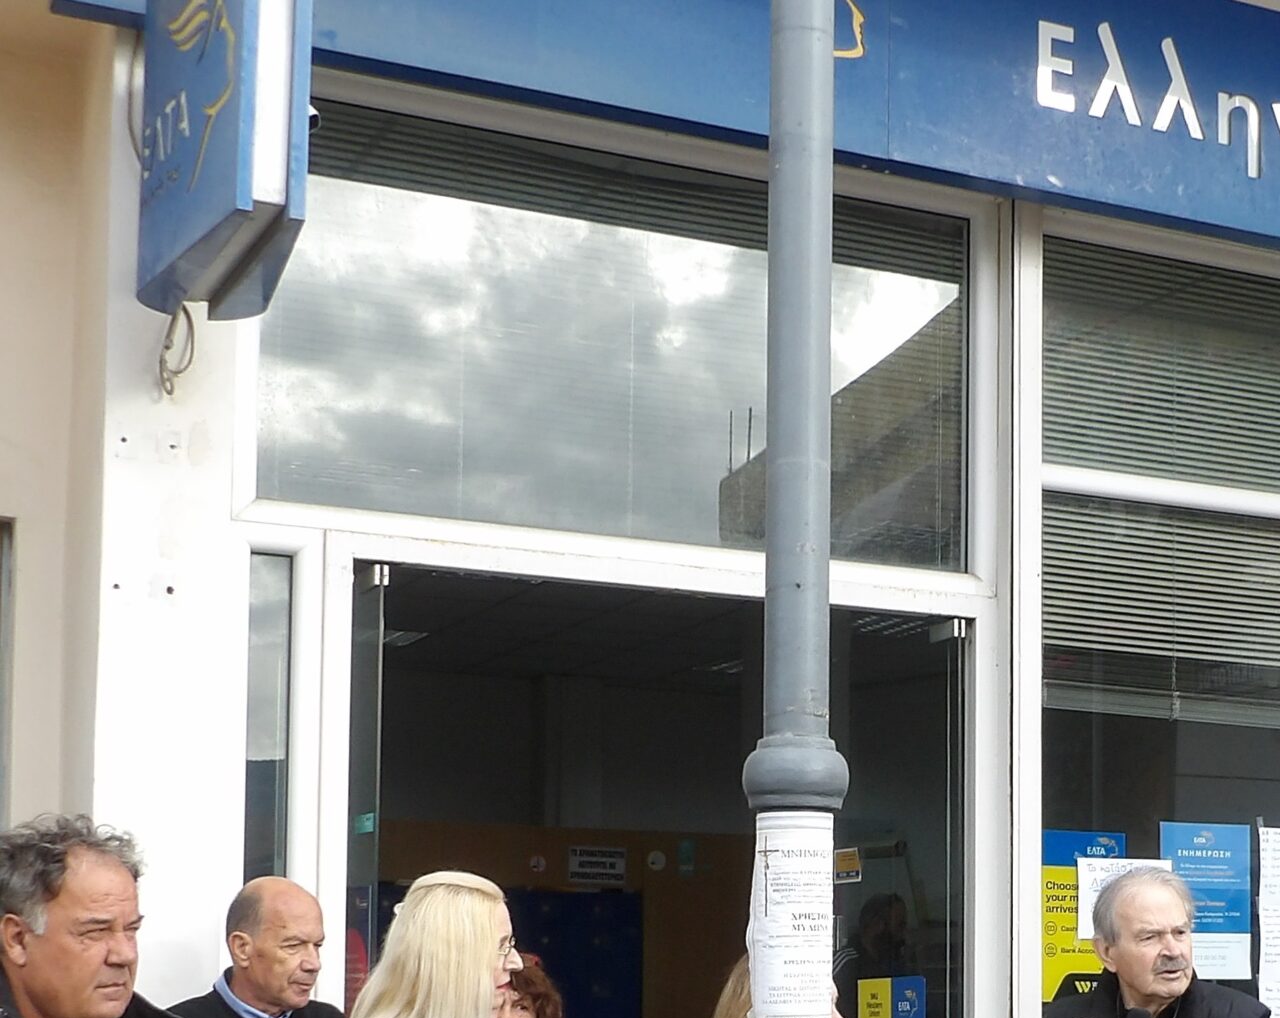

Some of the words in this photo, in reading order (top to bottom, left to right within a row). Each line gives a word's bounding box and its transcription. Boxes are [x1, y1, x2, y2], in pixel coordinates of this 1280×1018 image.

[1086, 846, 1106, 856] ΕΛΤΑ
[1177, 849, 1231, 858] ΕΝΗΜΕΡΩΣΗ
[1045, 880, 1079, 891] Choos
[1045, 894, 1068, 903] your
